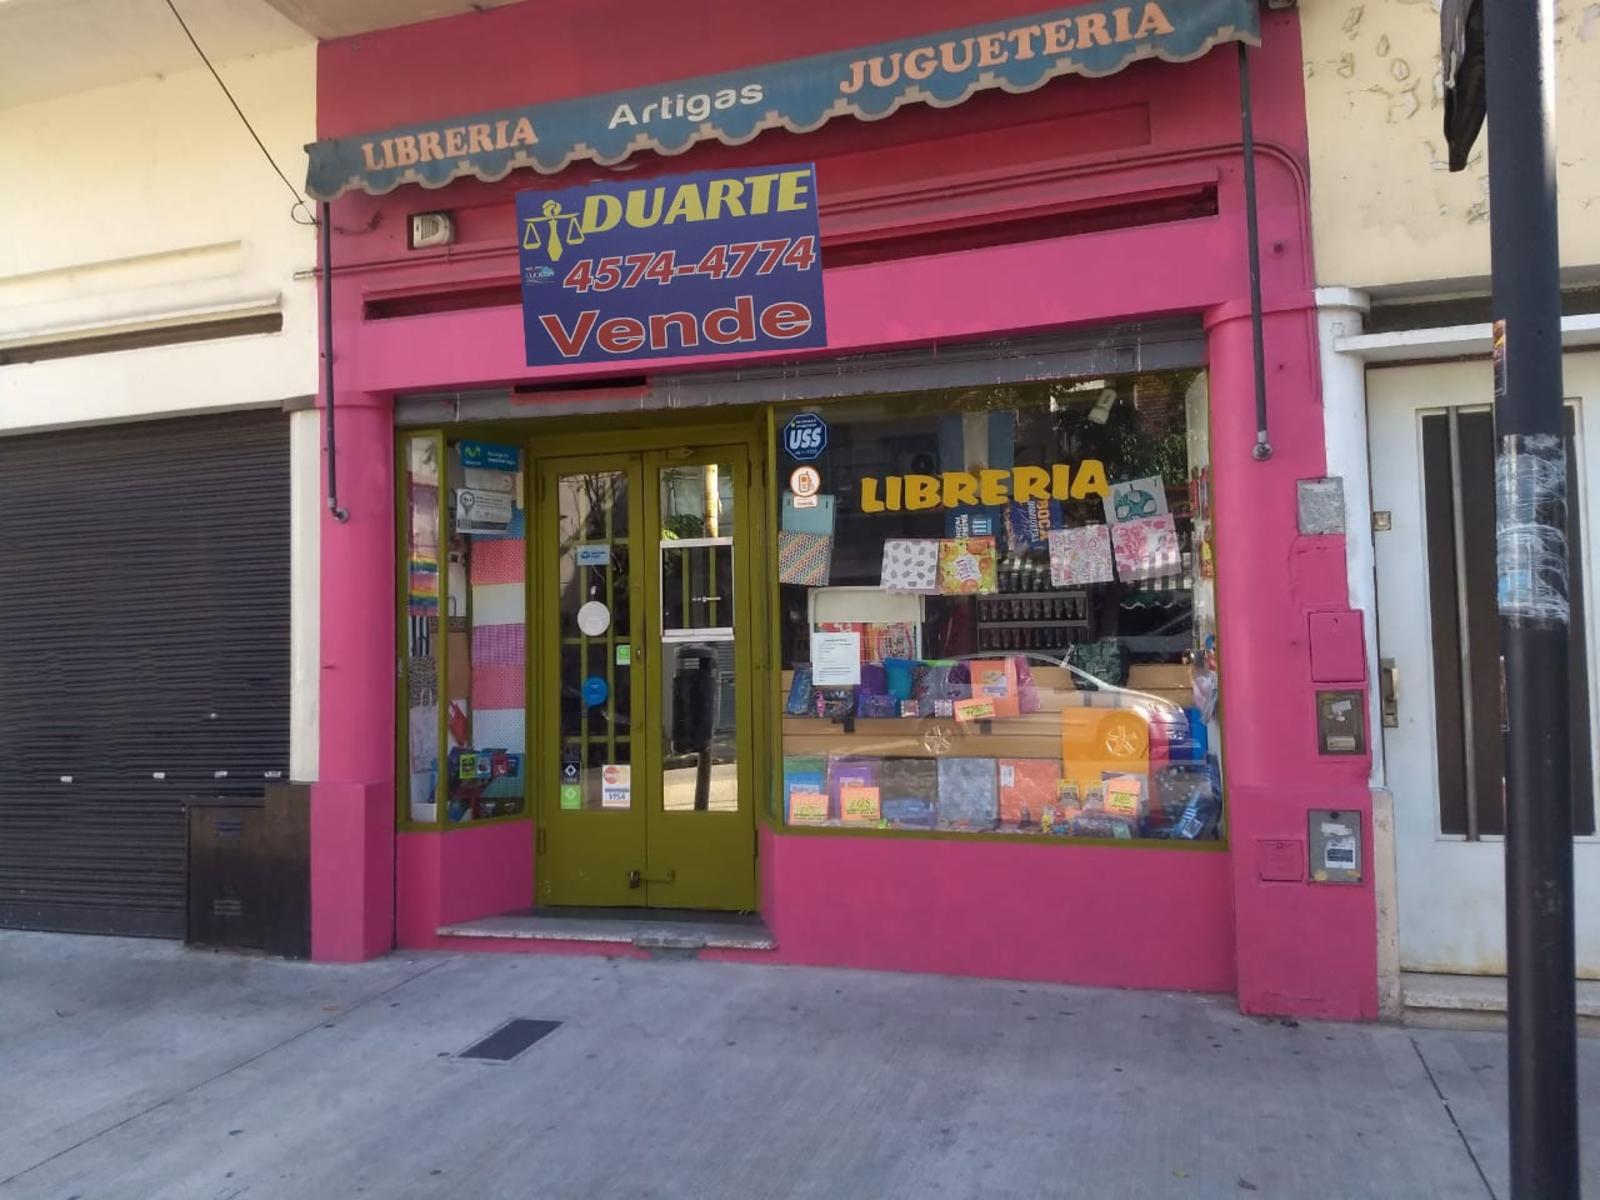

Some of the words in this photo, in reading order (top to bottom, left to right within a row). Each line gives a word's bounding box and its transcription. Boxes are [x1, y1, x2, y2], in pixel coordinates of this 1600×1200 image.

[839, 2, 1175, 93] JUGUETERIA
[608, 83, 765, 129] Artigas
[361, 117, 539, 171] LIBRERIA
[581, 169, 811, 234] DUARTE
[563, 235, 816, 294] 4574-4774
[538, 295, 812, 358] Vende
[789, 427, 822, 450] USS
[860, 459, 1110, 513] LIBRERIA
